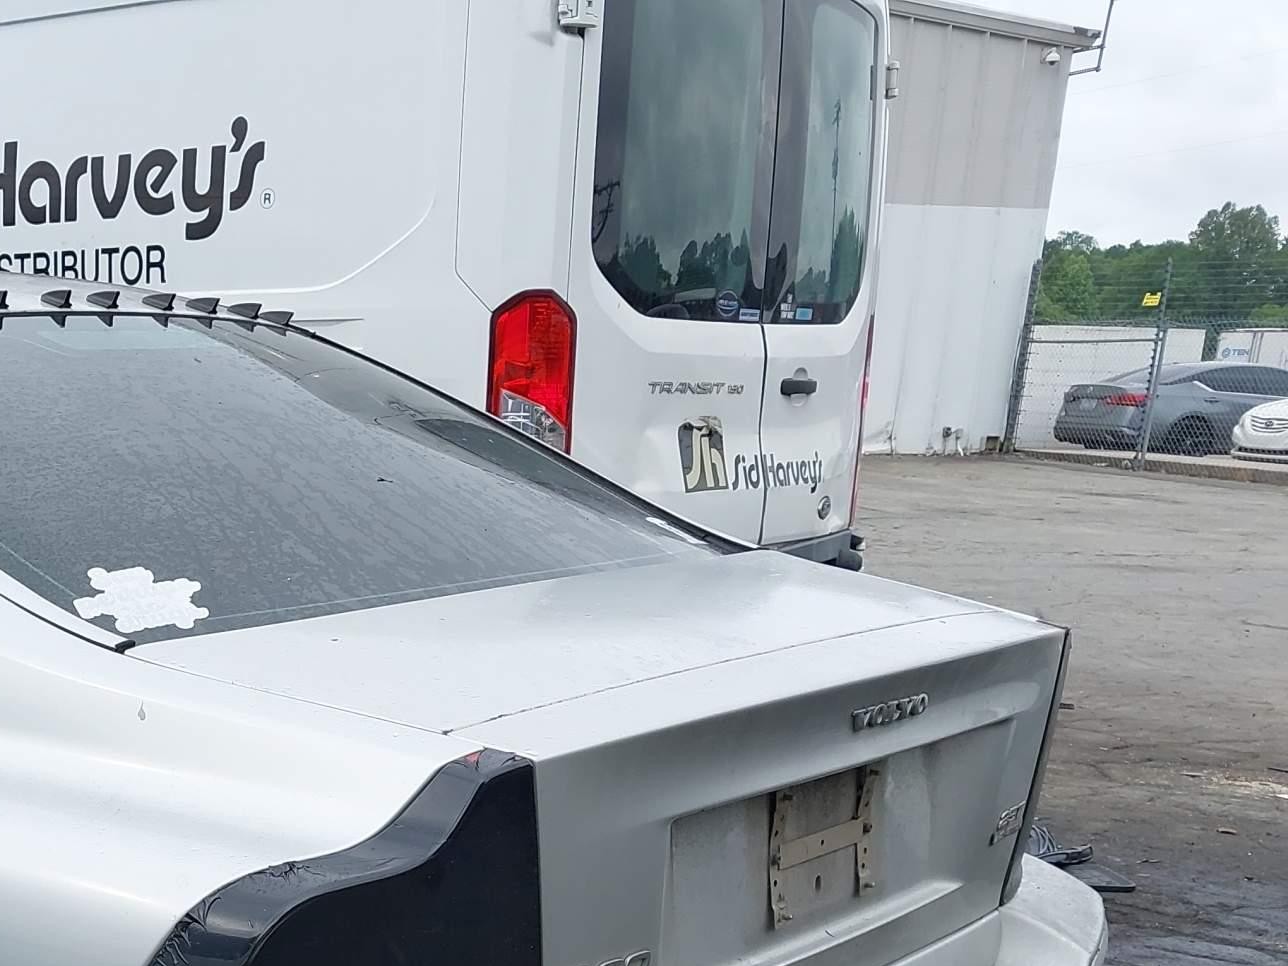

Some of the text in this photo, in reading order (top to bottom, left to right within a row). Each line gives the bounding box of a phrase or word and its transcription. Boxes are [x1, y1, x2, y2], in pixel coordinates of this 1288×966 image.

[648, 381, 726, 394] TRANSIT
[732, 451, 822, 494] Sid Harvey's
[851, 692, 929, 732] VOLVO
